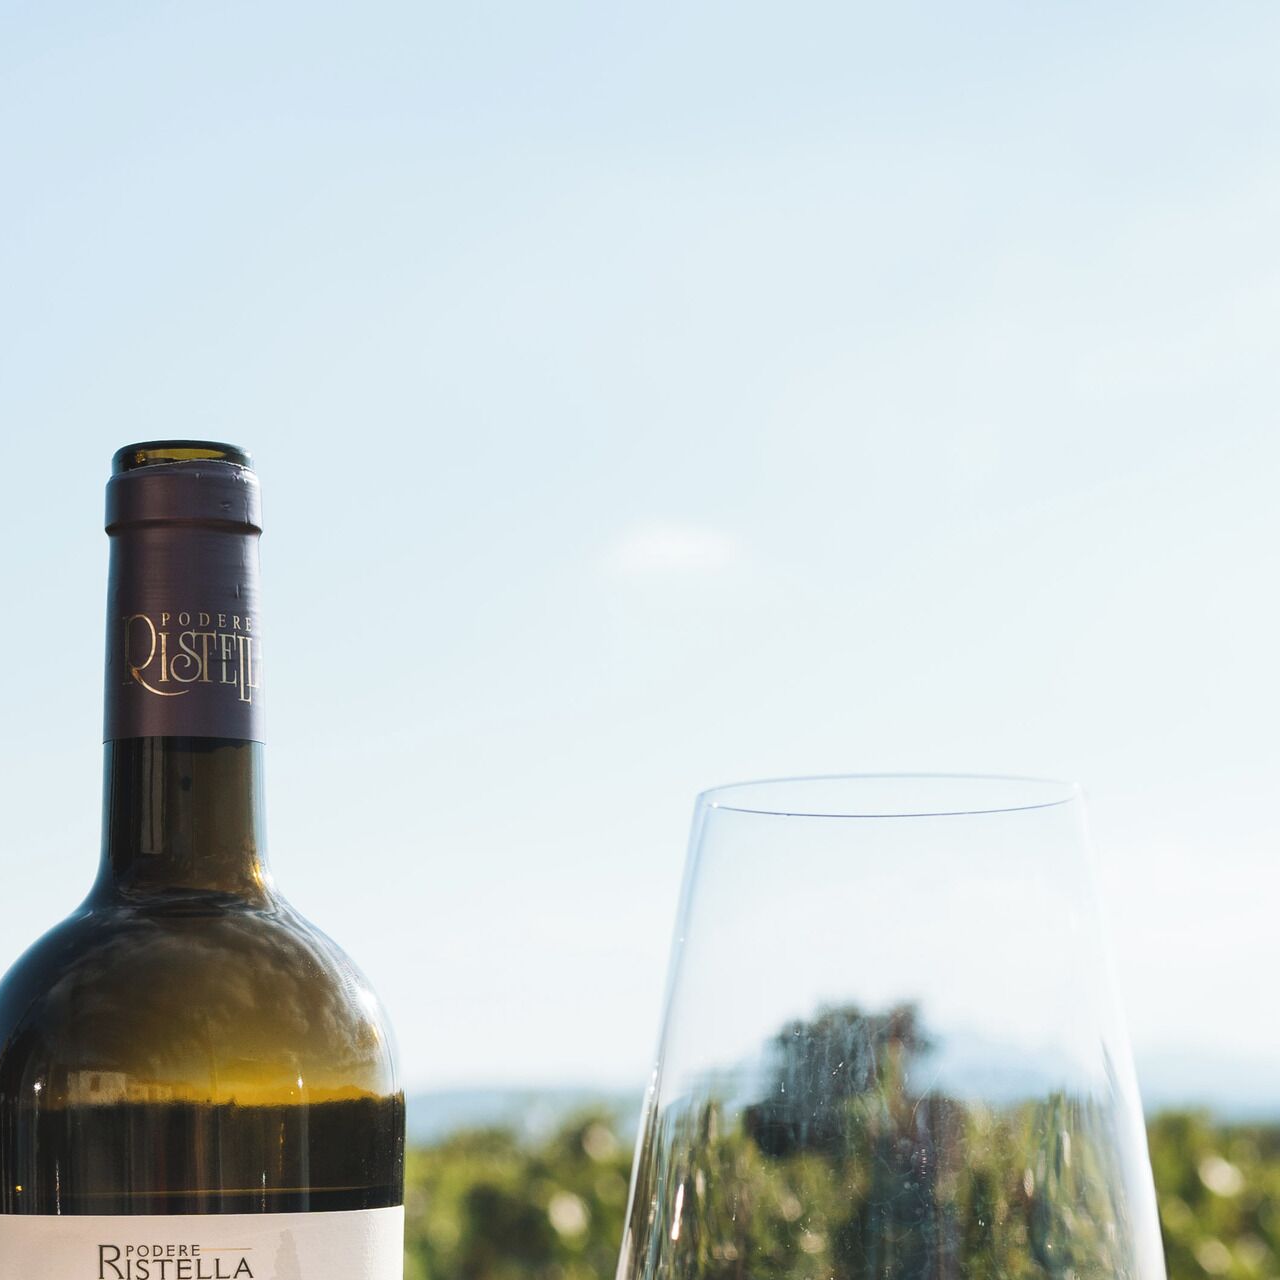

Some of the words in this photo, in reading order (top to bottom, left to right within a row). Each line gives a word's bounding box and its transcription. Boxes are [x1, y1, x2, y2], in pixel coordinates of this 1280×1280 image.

[161, 611, 253, 632] PODERE
[122, 613, 263, 705] RISTELL
[98, 1244, 254, 1280] RISTELLA
[126, 1243, 201, 1257] PODERE
